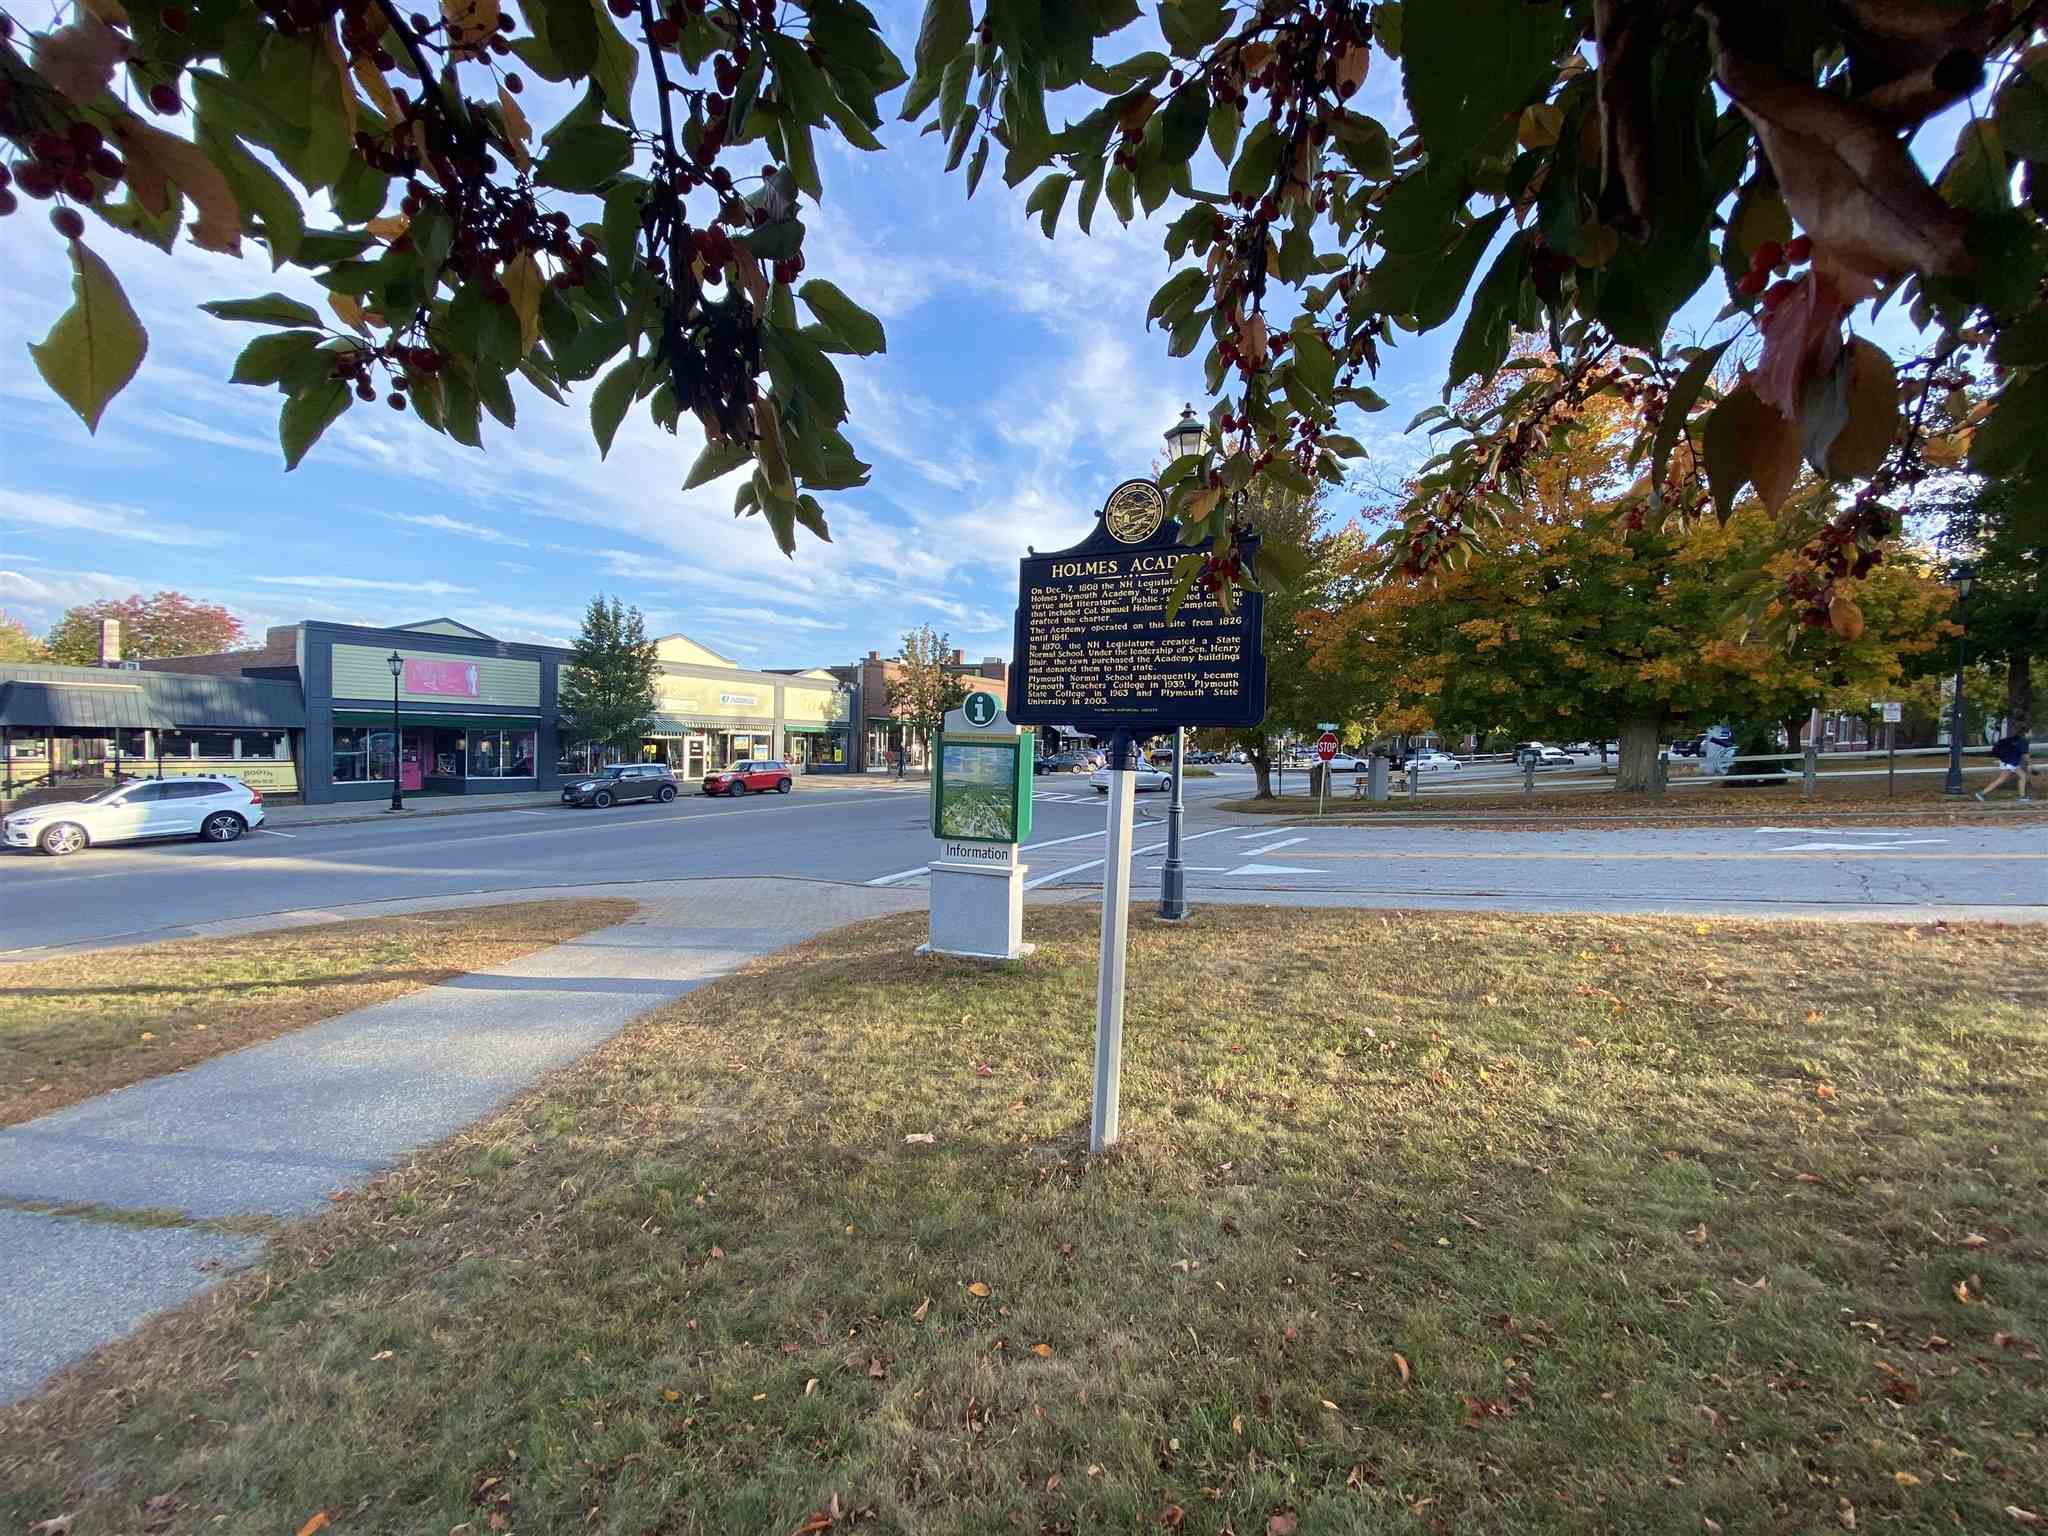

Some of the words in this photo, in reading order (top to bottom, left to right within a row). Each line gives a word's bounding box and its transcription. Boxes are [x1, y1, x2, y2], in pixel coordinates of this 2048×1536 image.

[1052, 560, 1118, 578] HOLMES
[1046, 586, 1062, 594] Dec.
[1079, 583, 1098, 592] 1808
[1101, 582, 1115, 590] the
[1120, 580, 1133, 588] NH
[1060, 592, 1098, 601] Plymouth
[1102, 589, 1140, 598] Academy
[1031, 602, 1054, 610] virtue
[1031, 610, 1046, 618] that
[1048, 608, 1080, 617] included
[1101, 606, 1129, 614] Samuel
[1133, 604, 1162, 612] Holmes
[1080, 615, 1112, 623] charter.
[1030, 626, 1046, 634] The
[1050, 626, 1086, 635] Academy
[1090, 622, 1128, 633] operated
[1132, 622, 1144, 630] on
[1169, 620, 1186, 628] site
[1192, 618, 1214, 626] from
[1219, 616, 1242, 626] 1826
[1030, 634, 1048, 642] until
[1068, 642, 1082, 650] the
[1106, 640, 1155, 649] Legislature
[1162, 638, 1196, 646] created
[1216, 636, 1240, 644] State
[1029, 650, 1056, 658] Normal
[1088, 649, 1112, 657] Under
[1115, 648, 1128, 656] the
[1130, 646, 1174, 655] leadership
[1176, 646, 1186, 654] of
[1210, 644, 1240, 654] Henry
[1054, 658, 1066, 666] the
[1092, 656, 1134, 665] purchased
[1154, 654, 1195, 664] Academy
[1198, 653, 1240, 662] buildings
[1028, 666, 1043, 674] and
[1115, 664, 1128, 672] the
[1028, 674, 1064, 683] Plymouth
[1070, 674, 1099, 682] Normal
[1104, 673, 1133, 681] School
[1138, 672, 1197, 681] subsequently
[1204, 671, 1240, 680] became
[1028, 682, 1064, 690] Plymouth
[1070, 682, 1106, 690] Teachers
[1112, 680, 1144, 690] College
[1150, 680, 1159, 688] in
[1194, 680, 1240, 688] Plymouth
[1028, 690, 1048, 698] State
[1055, 690, 1086, 698] College
[1094, 689, 1102, 697] in
[1110, 688, 1129, 697] 1963
[1136, 689, 1152, 697] and
[1160, 688, 1204, 698] Plymouth
[1212, 688, 1239, 696] State
[1027, 698, 1066, 706] University
[1072, 697, 1080, 705] in
[1318, 742, 1337, 752] STOP
[946, 842, 1008, 861] Information
